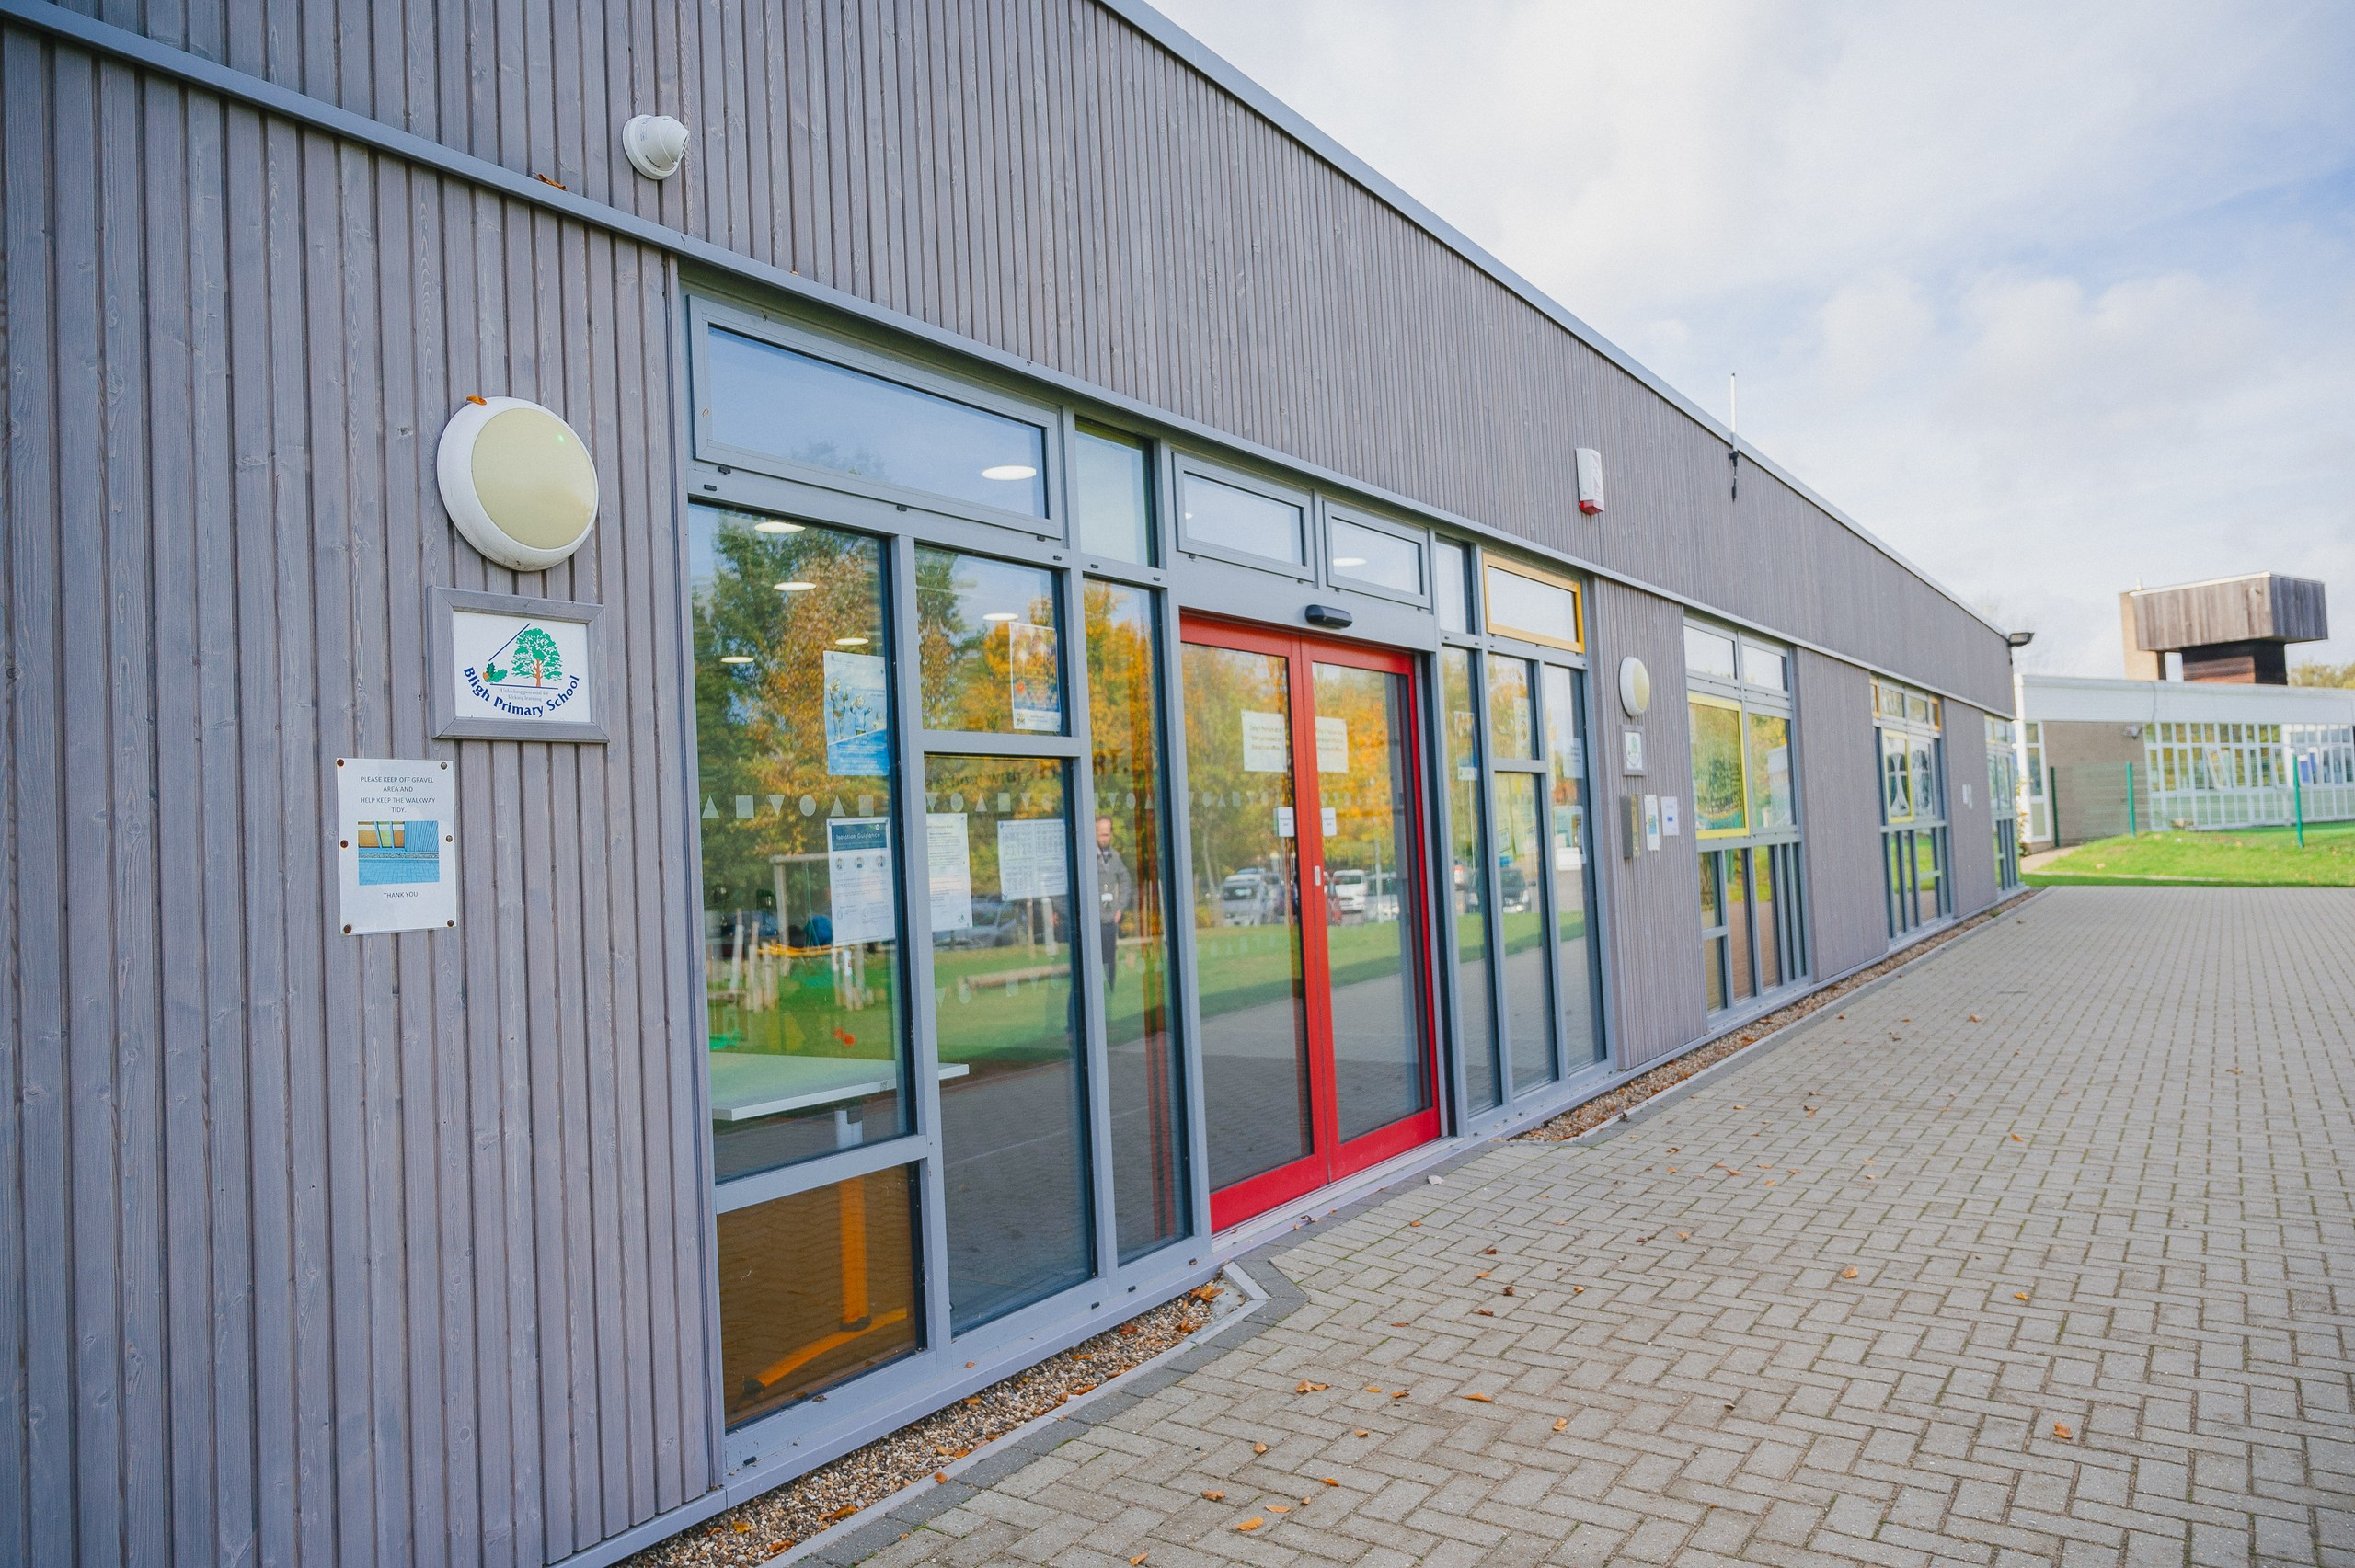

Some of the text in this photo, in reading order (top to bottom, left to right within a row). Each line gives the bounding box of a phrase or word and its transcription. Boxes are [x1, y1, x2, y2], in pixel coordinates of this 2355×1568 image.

[464, 667, 580, 718] Bligh Primary School
